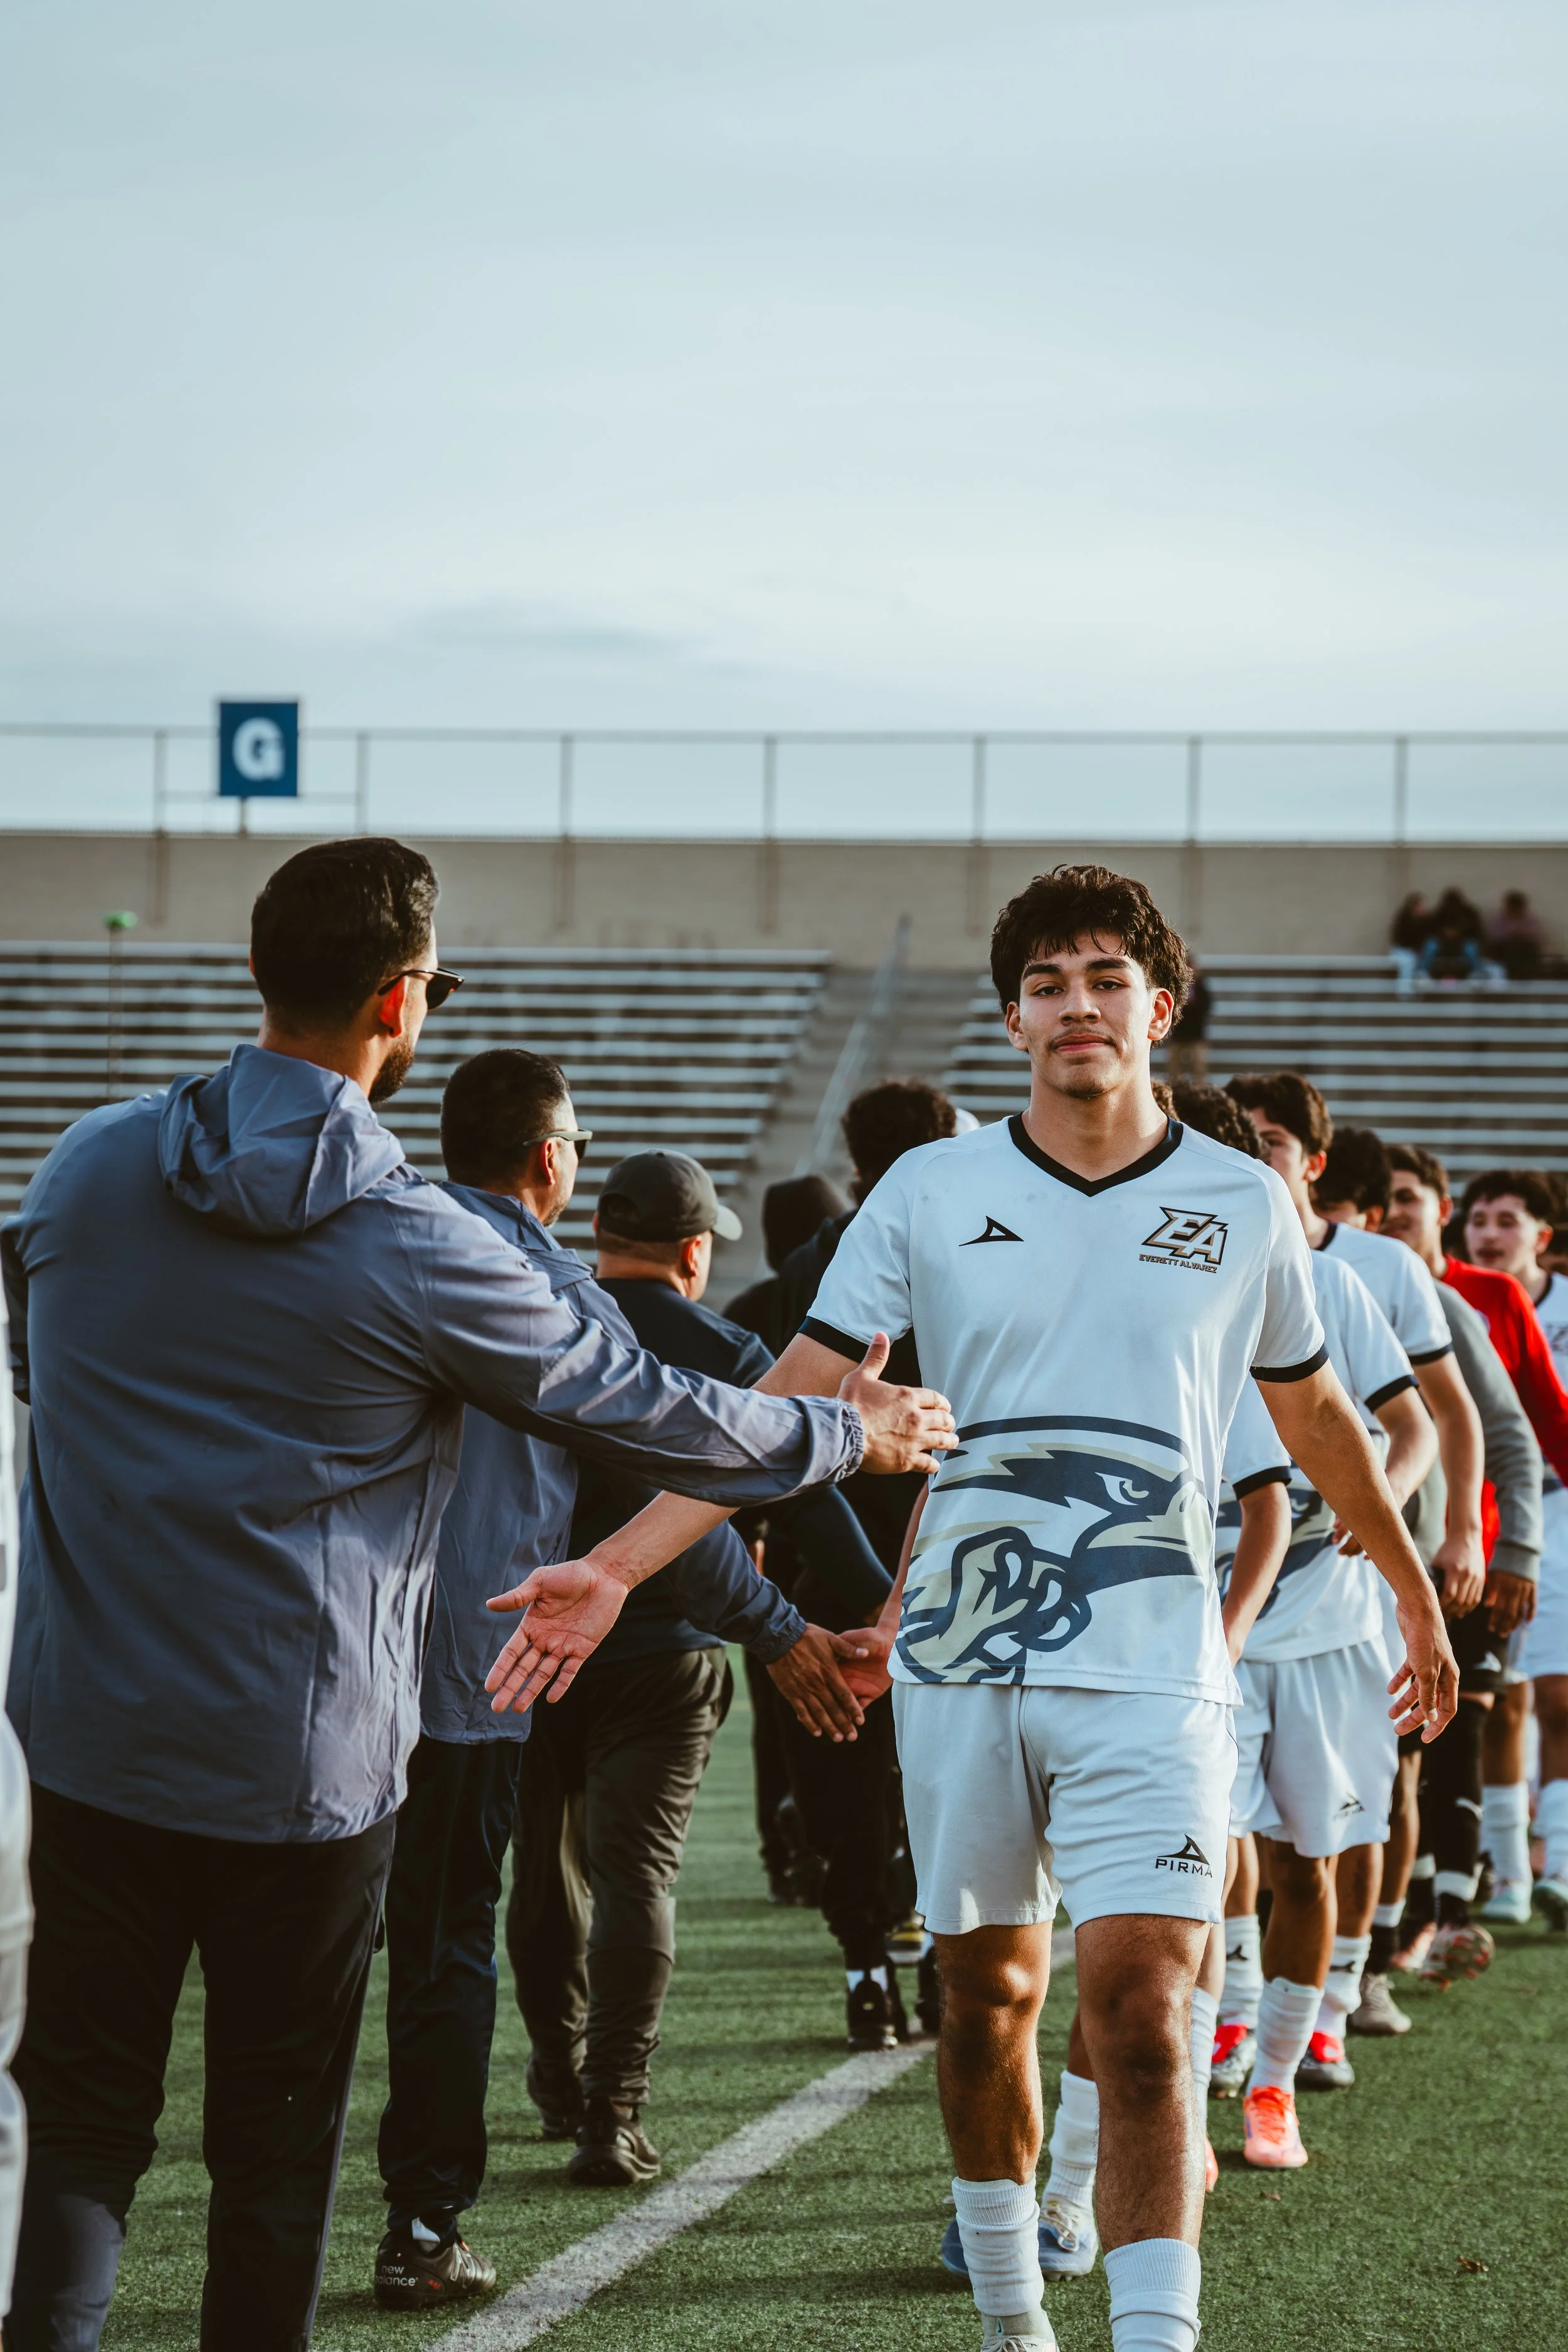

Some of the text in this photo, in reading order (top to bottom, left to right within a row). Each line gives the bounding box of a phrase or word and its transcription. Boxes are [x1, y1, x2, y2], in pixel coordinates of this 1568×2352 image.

[233, 717, 285, 781] G
[1141, 1206, 1229, 1265] EA
[1139, 1254, 1217, 1273] EVERETT ALVAREZ
[1155, 1858, 1212, 1878] PIRMA
[381, 2265, 405, 2274] new
